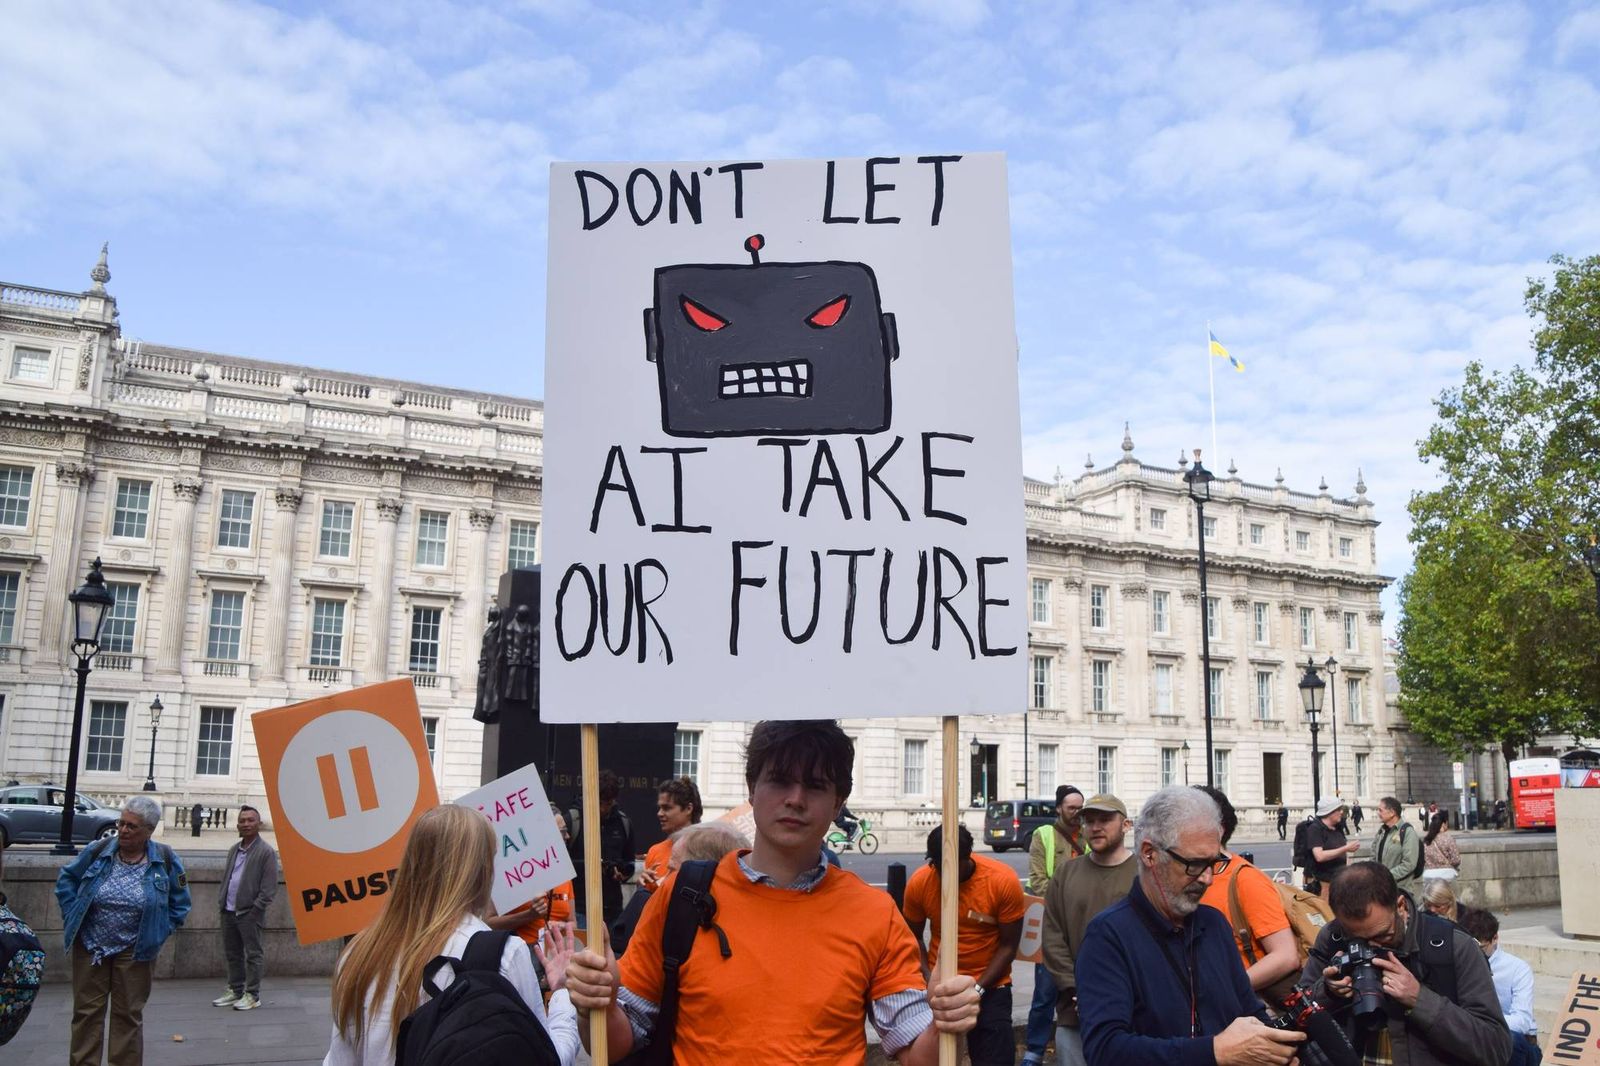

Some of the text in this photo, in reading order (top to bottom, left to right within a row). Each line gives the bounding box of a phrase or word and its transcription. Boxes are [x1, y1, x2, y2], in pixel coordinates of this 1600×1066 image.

[575, 156, 963, 231] DON'T LET
[590, 432, 975, 534] AI TAKE
[555, 541, 1018, 666] OUR FUTURE
[503, 827, 528, 858] AI
[505, 846, 560, 888] NOW!
